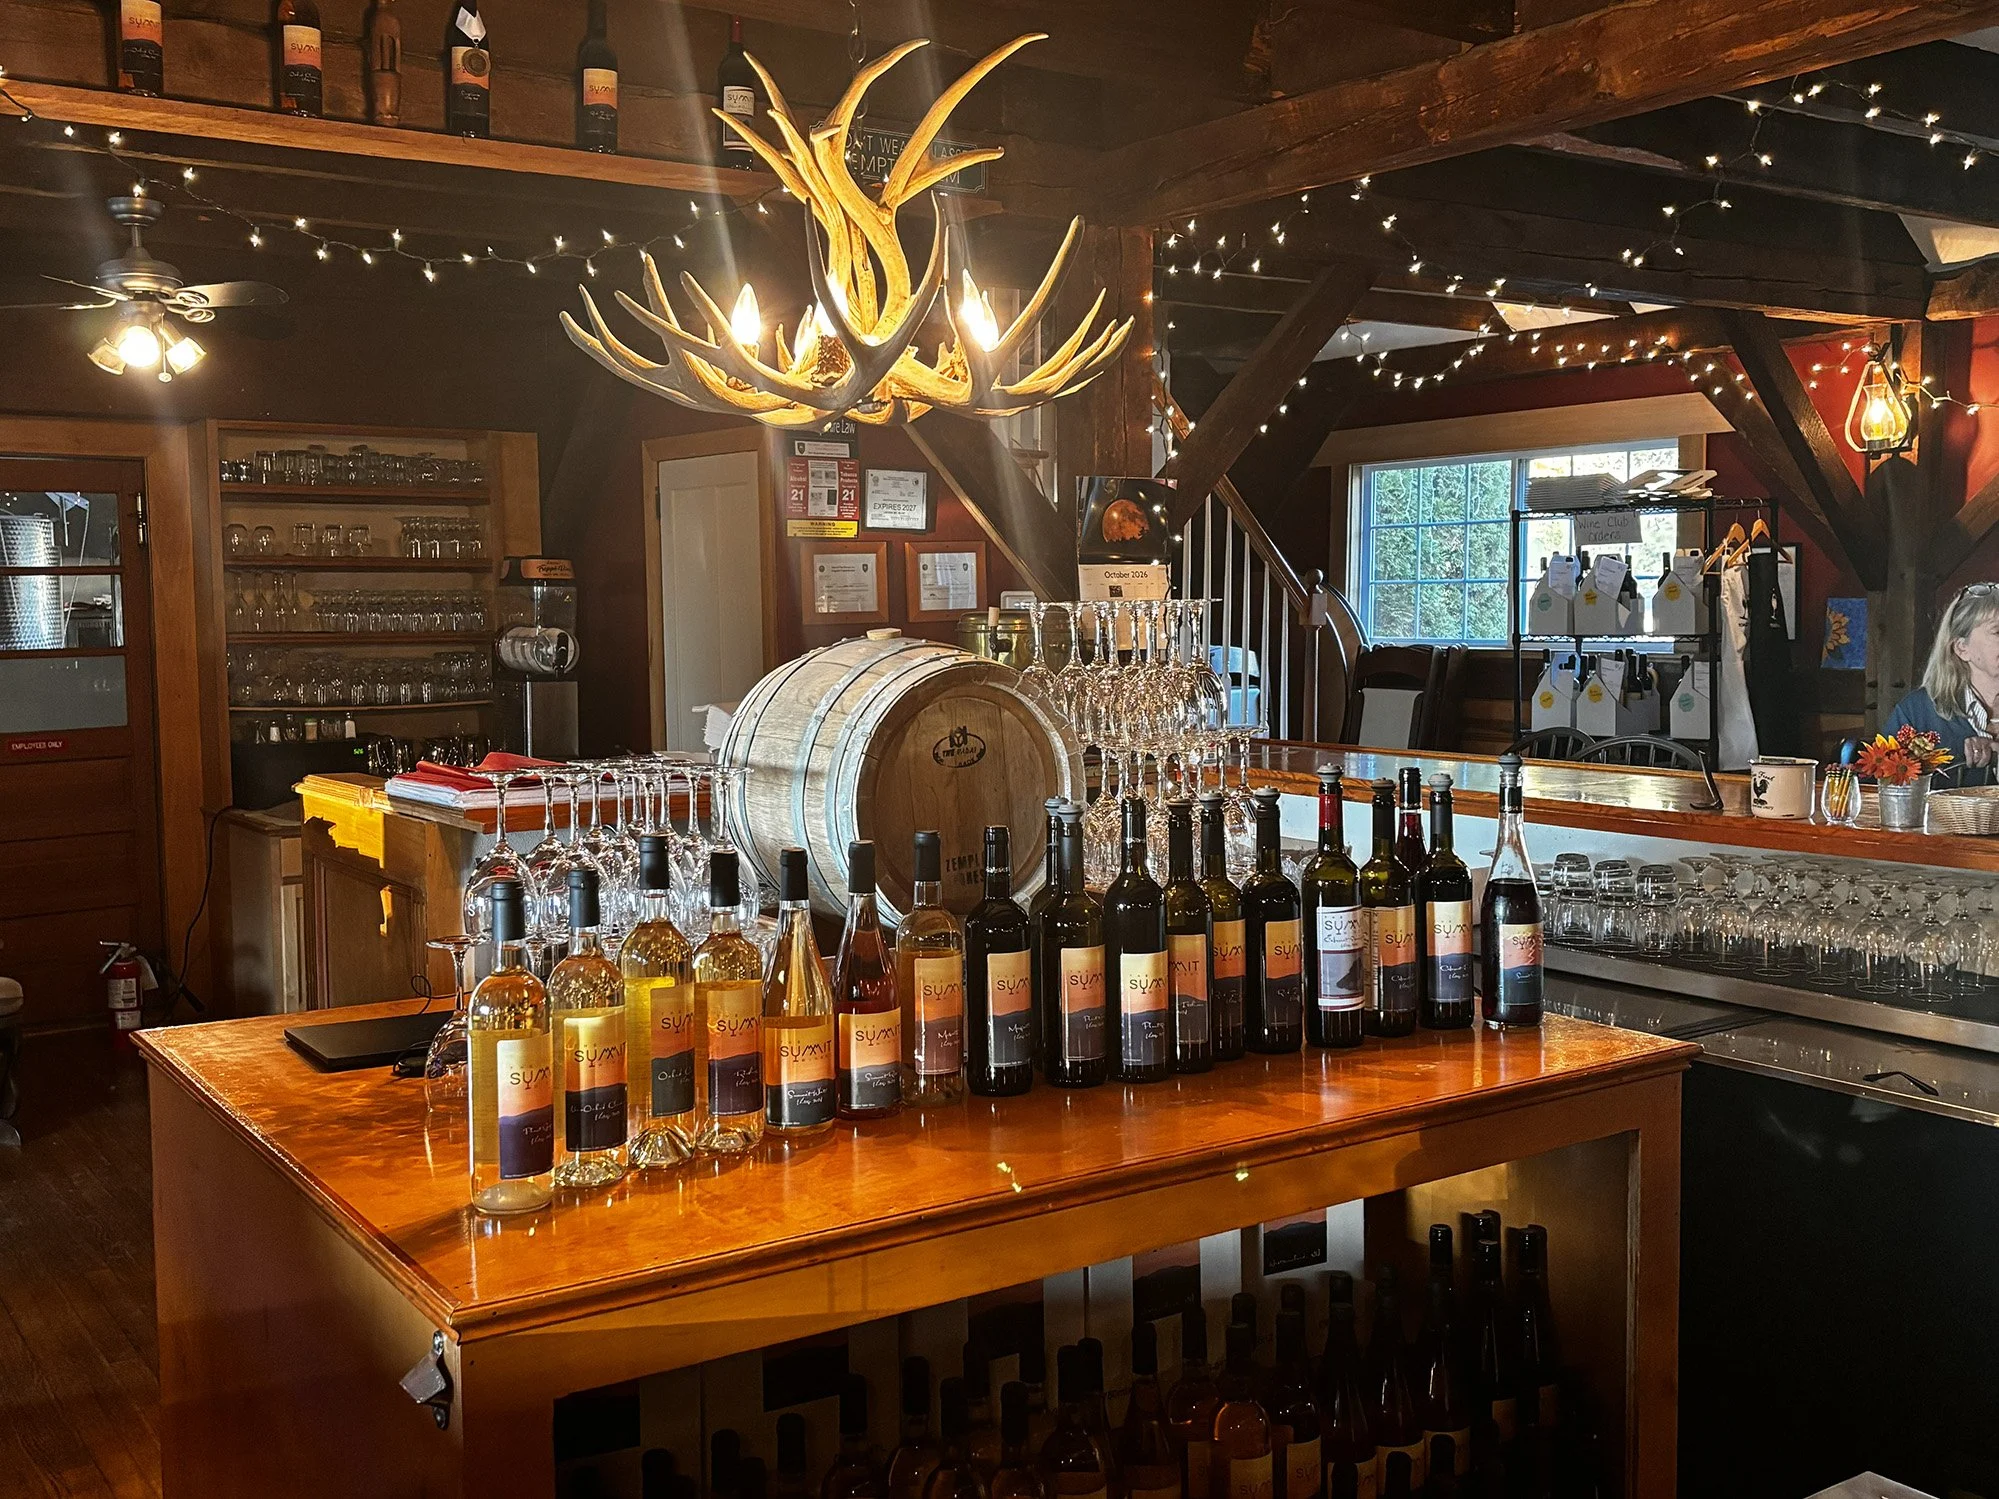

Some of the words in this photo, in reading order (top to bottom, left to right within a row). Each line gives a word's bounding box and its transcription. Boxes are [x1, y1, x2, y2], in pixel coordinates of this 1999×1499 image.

[879, 137, 905, 155] WEA
[851, 153, 895, 173] EMPT
[791, 488, 804, 501] 21
[842, 488, 855, 501] 21
[873, 502, 901, 511] EXPIRES
[902, 503, 917, 511] 2027
[1578, 518, 1601, 529] Wine
[1607, 515, 1629, 527] Club
[1104, 570, 1130, 579] October
[1131, 570, 1149, 579] 2026
[12, 742, 46, 750] EMPLOYEES
[47, 740, 63, 748] ONLY
[945, 853, 984, 872] ZEMPL
[779, 1039, 832, 1063] SUMMIT
